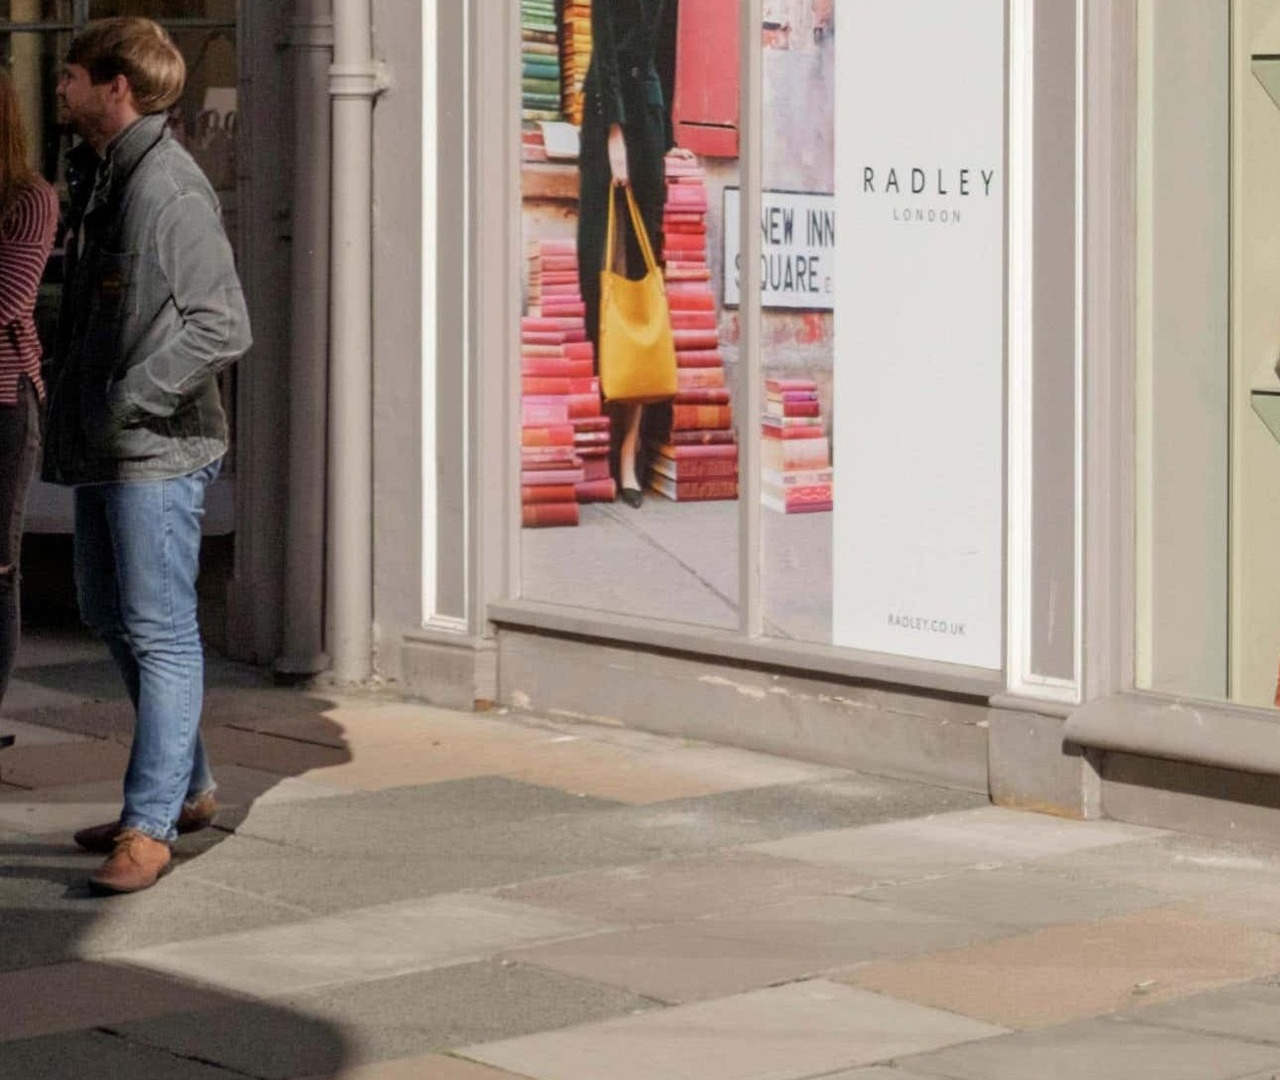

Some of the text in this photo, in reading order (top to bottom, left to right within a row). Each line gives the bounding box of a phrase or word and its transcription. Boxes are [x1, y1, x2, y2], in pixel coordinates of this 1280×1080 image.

[863, 166, 994, 196] RADLEY
[807, 208, 835, 248] INN
[893, 207, 961, 223] LONDON
